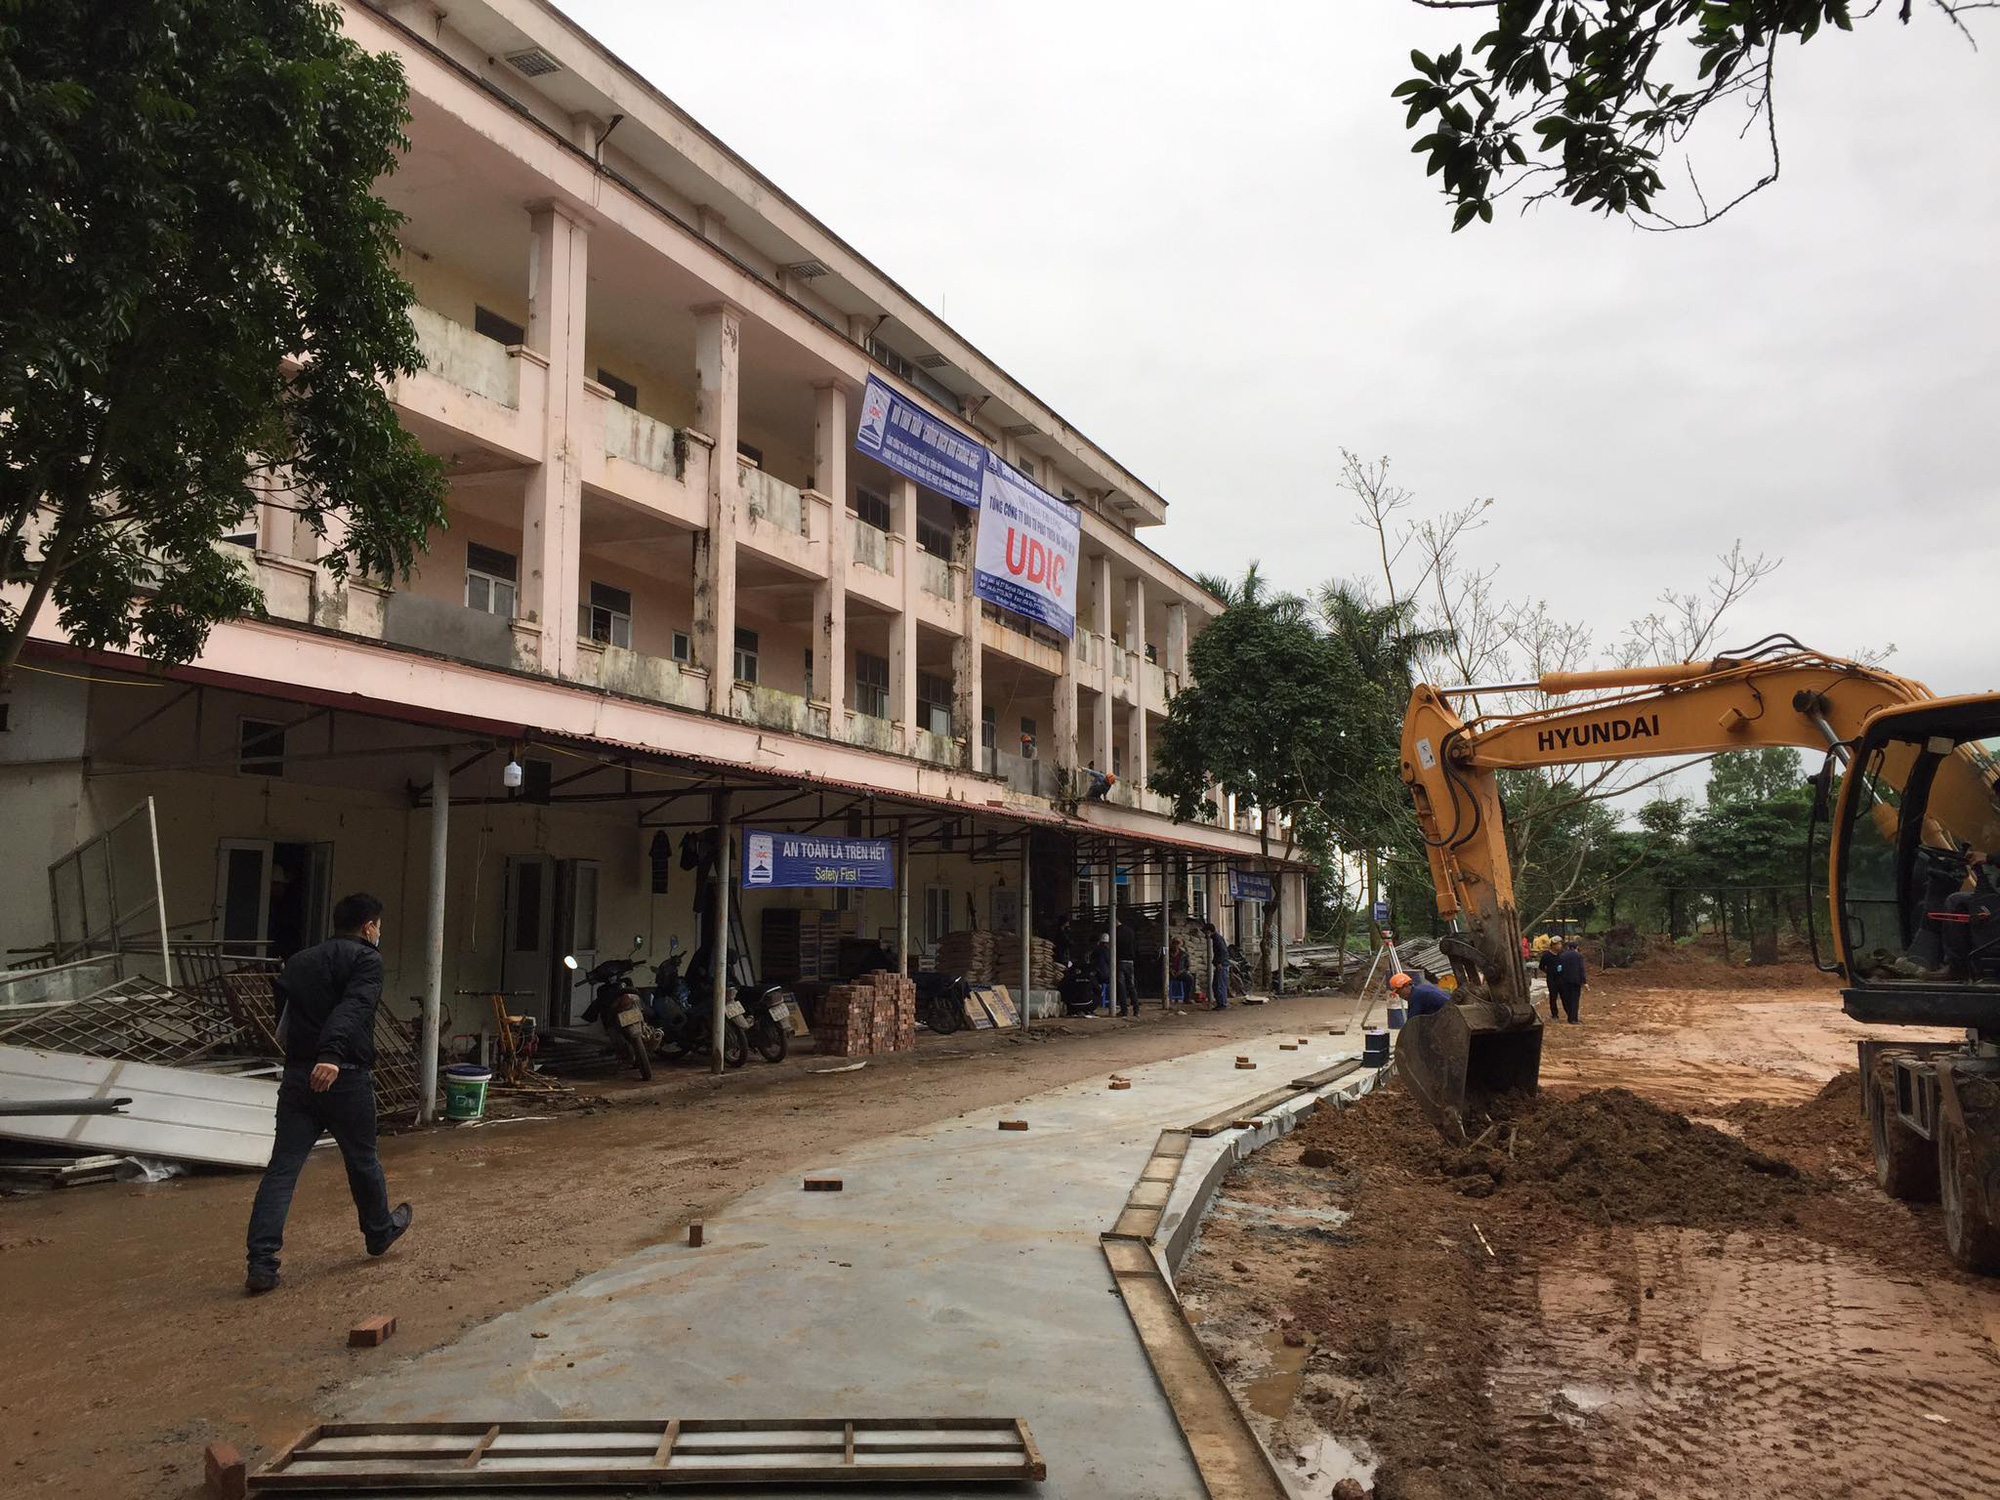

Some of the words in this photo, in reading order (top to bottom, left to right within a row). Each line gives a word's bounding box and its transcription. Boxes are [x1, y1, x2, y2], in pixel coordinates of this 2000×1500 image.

[1006, 526, 1065, 599] UDIC
[1538, 714, 1660, 751] HYUNDAI
[783, 841, 799, 857] AN
[800, 839, 829, 859] TOÀN
[830, 841, 843, 859] LÀ
[845, 842, 868, 860] TRÊN
[815, 866, 839, 884] Safety
